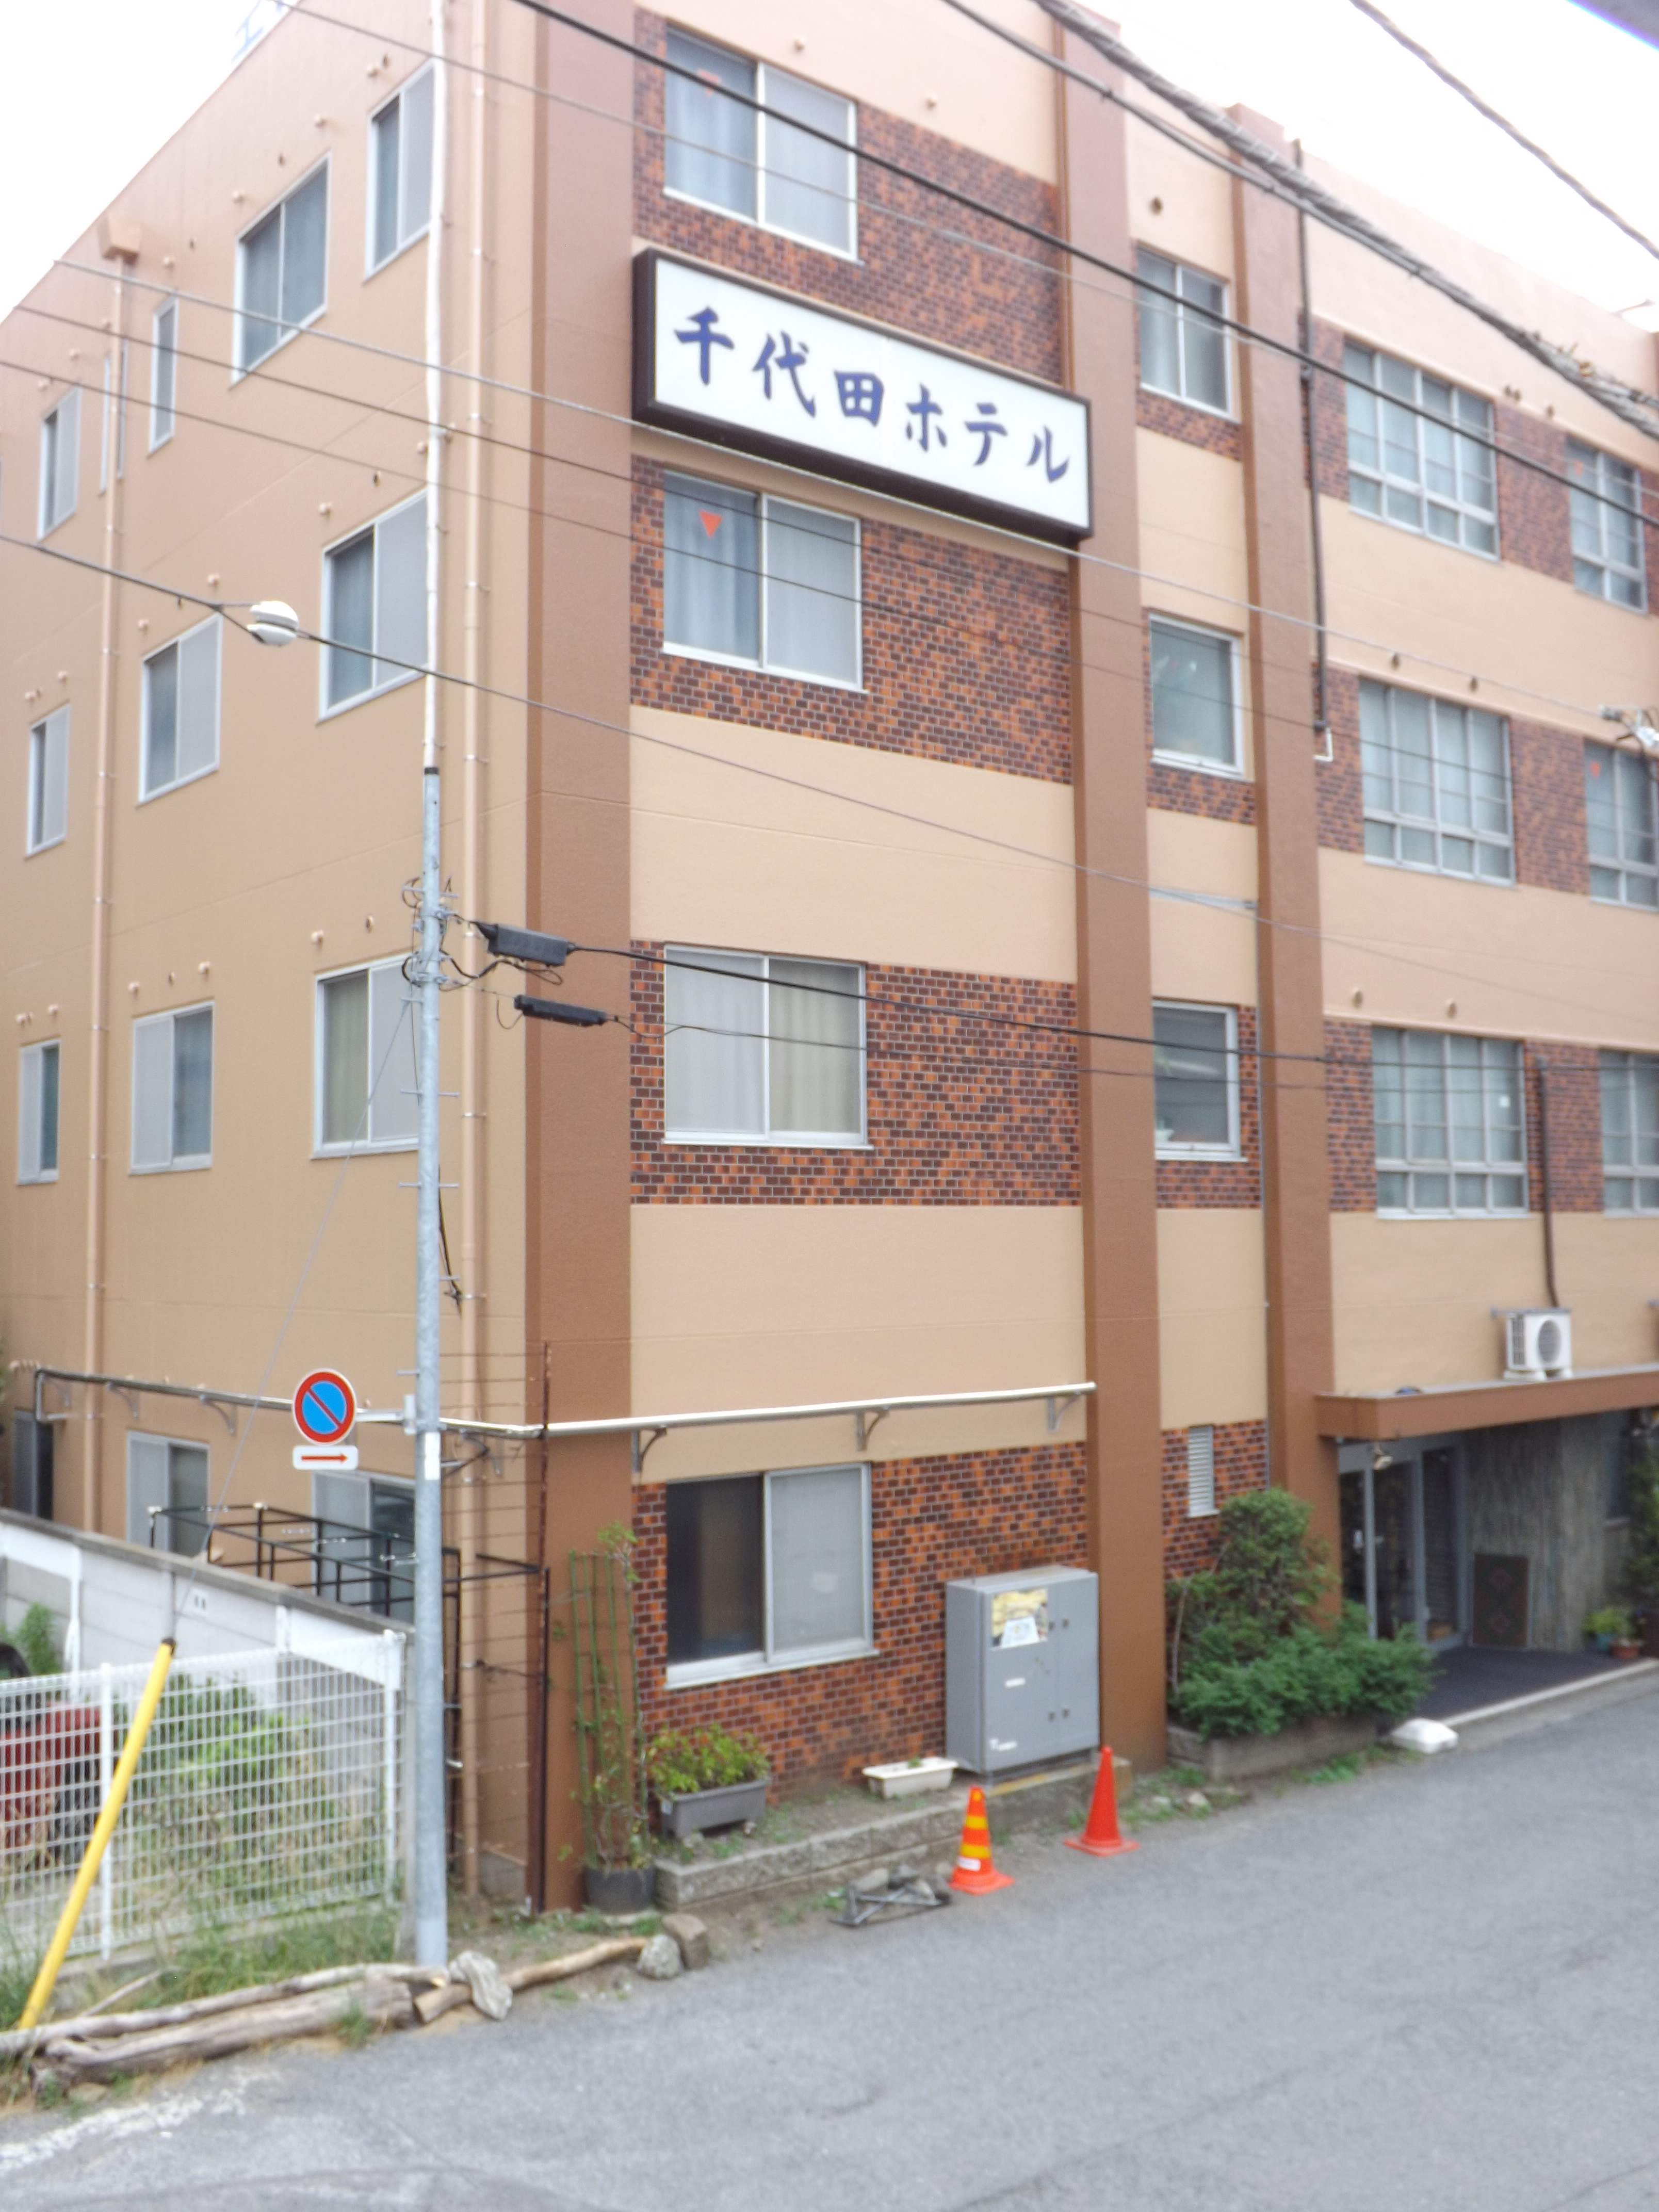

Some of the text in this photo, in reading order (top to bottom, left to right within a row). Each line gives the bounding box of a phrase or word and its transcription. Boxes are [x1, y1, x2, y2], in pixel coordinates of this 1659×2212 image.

[675, 307, 1069, 482] 千代田ホテル
